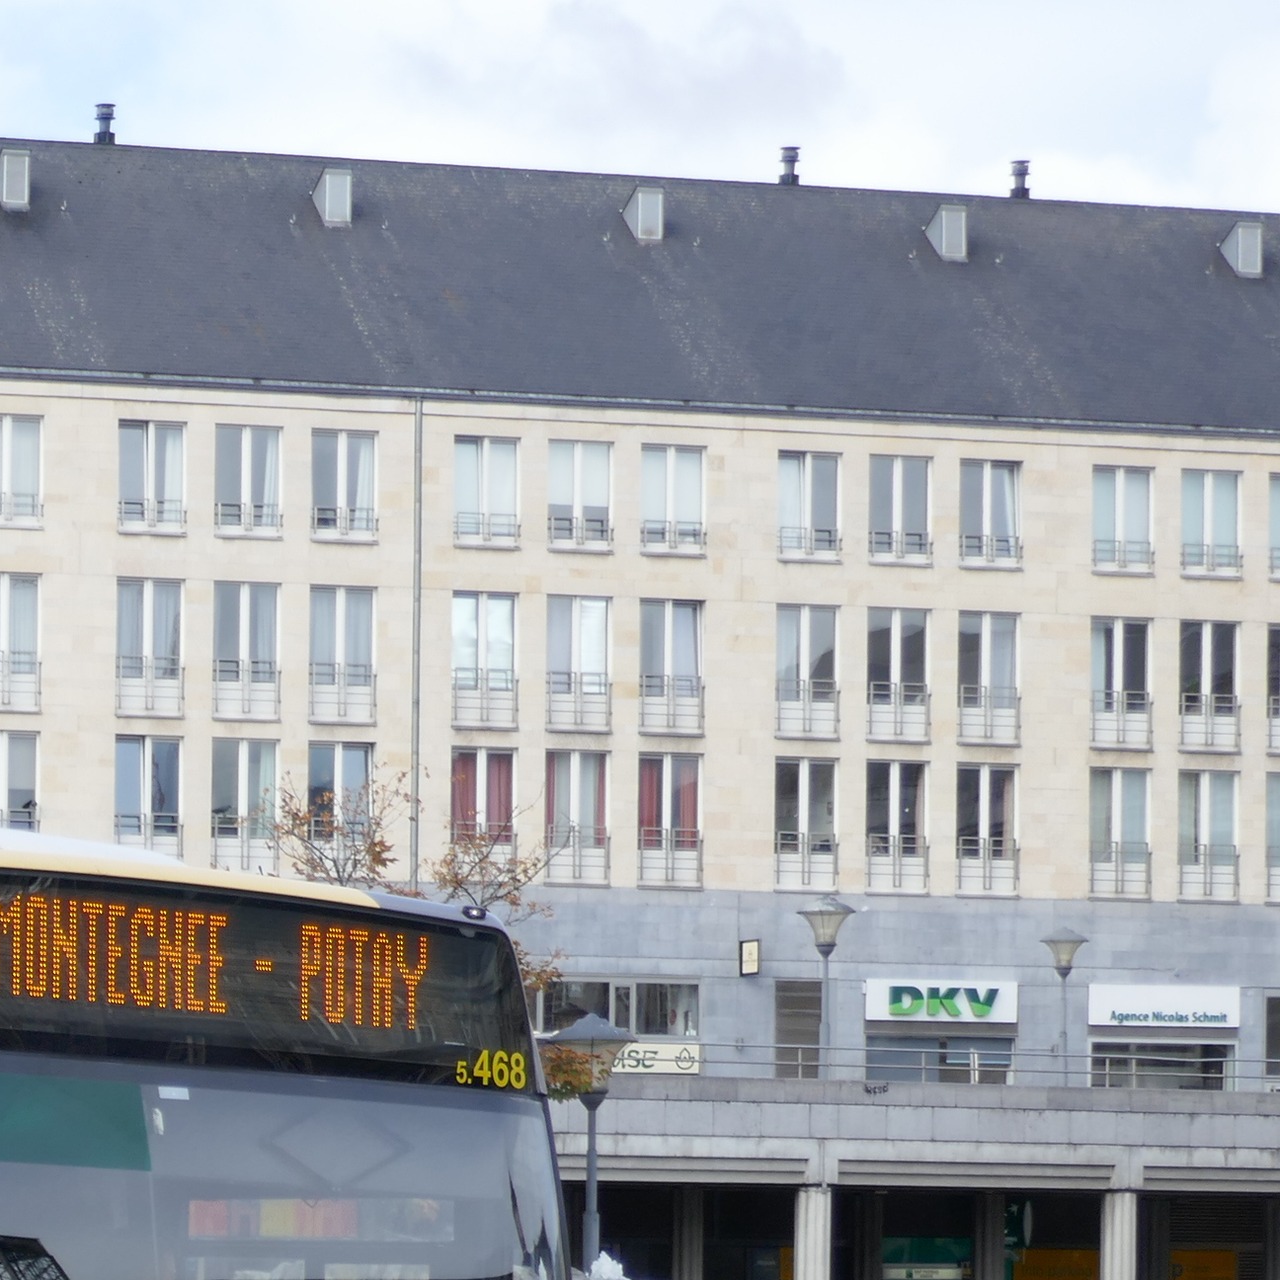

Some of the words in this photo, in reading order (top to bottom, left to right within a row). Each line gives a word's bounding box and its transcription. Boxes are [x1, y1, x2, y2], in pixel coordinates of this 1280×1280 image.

[300, 924, 429, 1031] POTAY
[888, 985, 1000, 1018] DKV
[1110, 1010, 1149, 1024] Agence
[1151, 1011, 1189, 1023] Nicolas
[1192, 1011, 1228, 1023] Schmit
[456, 1049, 526, 1090] 5.468
